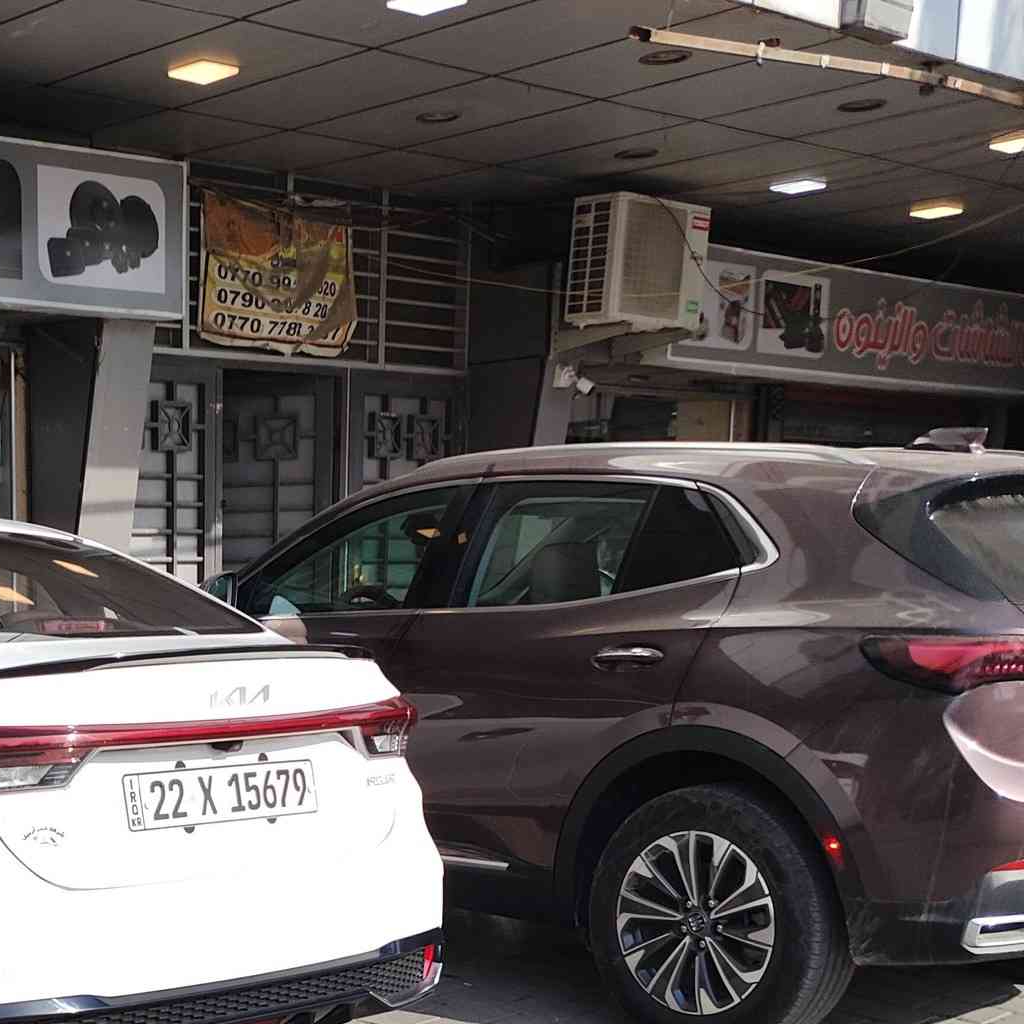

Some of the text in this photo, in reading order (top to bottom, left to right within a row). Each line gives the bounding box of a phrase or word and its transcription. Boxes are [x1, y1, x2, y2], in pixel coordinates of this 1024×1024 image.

[217, 288, 266, 310] 0790
[214, 312, 262, 334] 0770
[150, 767, 307, 821] 22 X 15679
